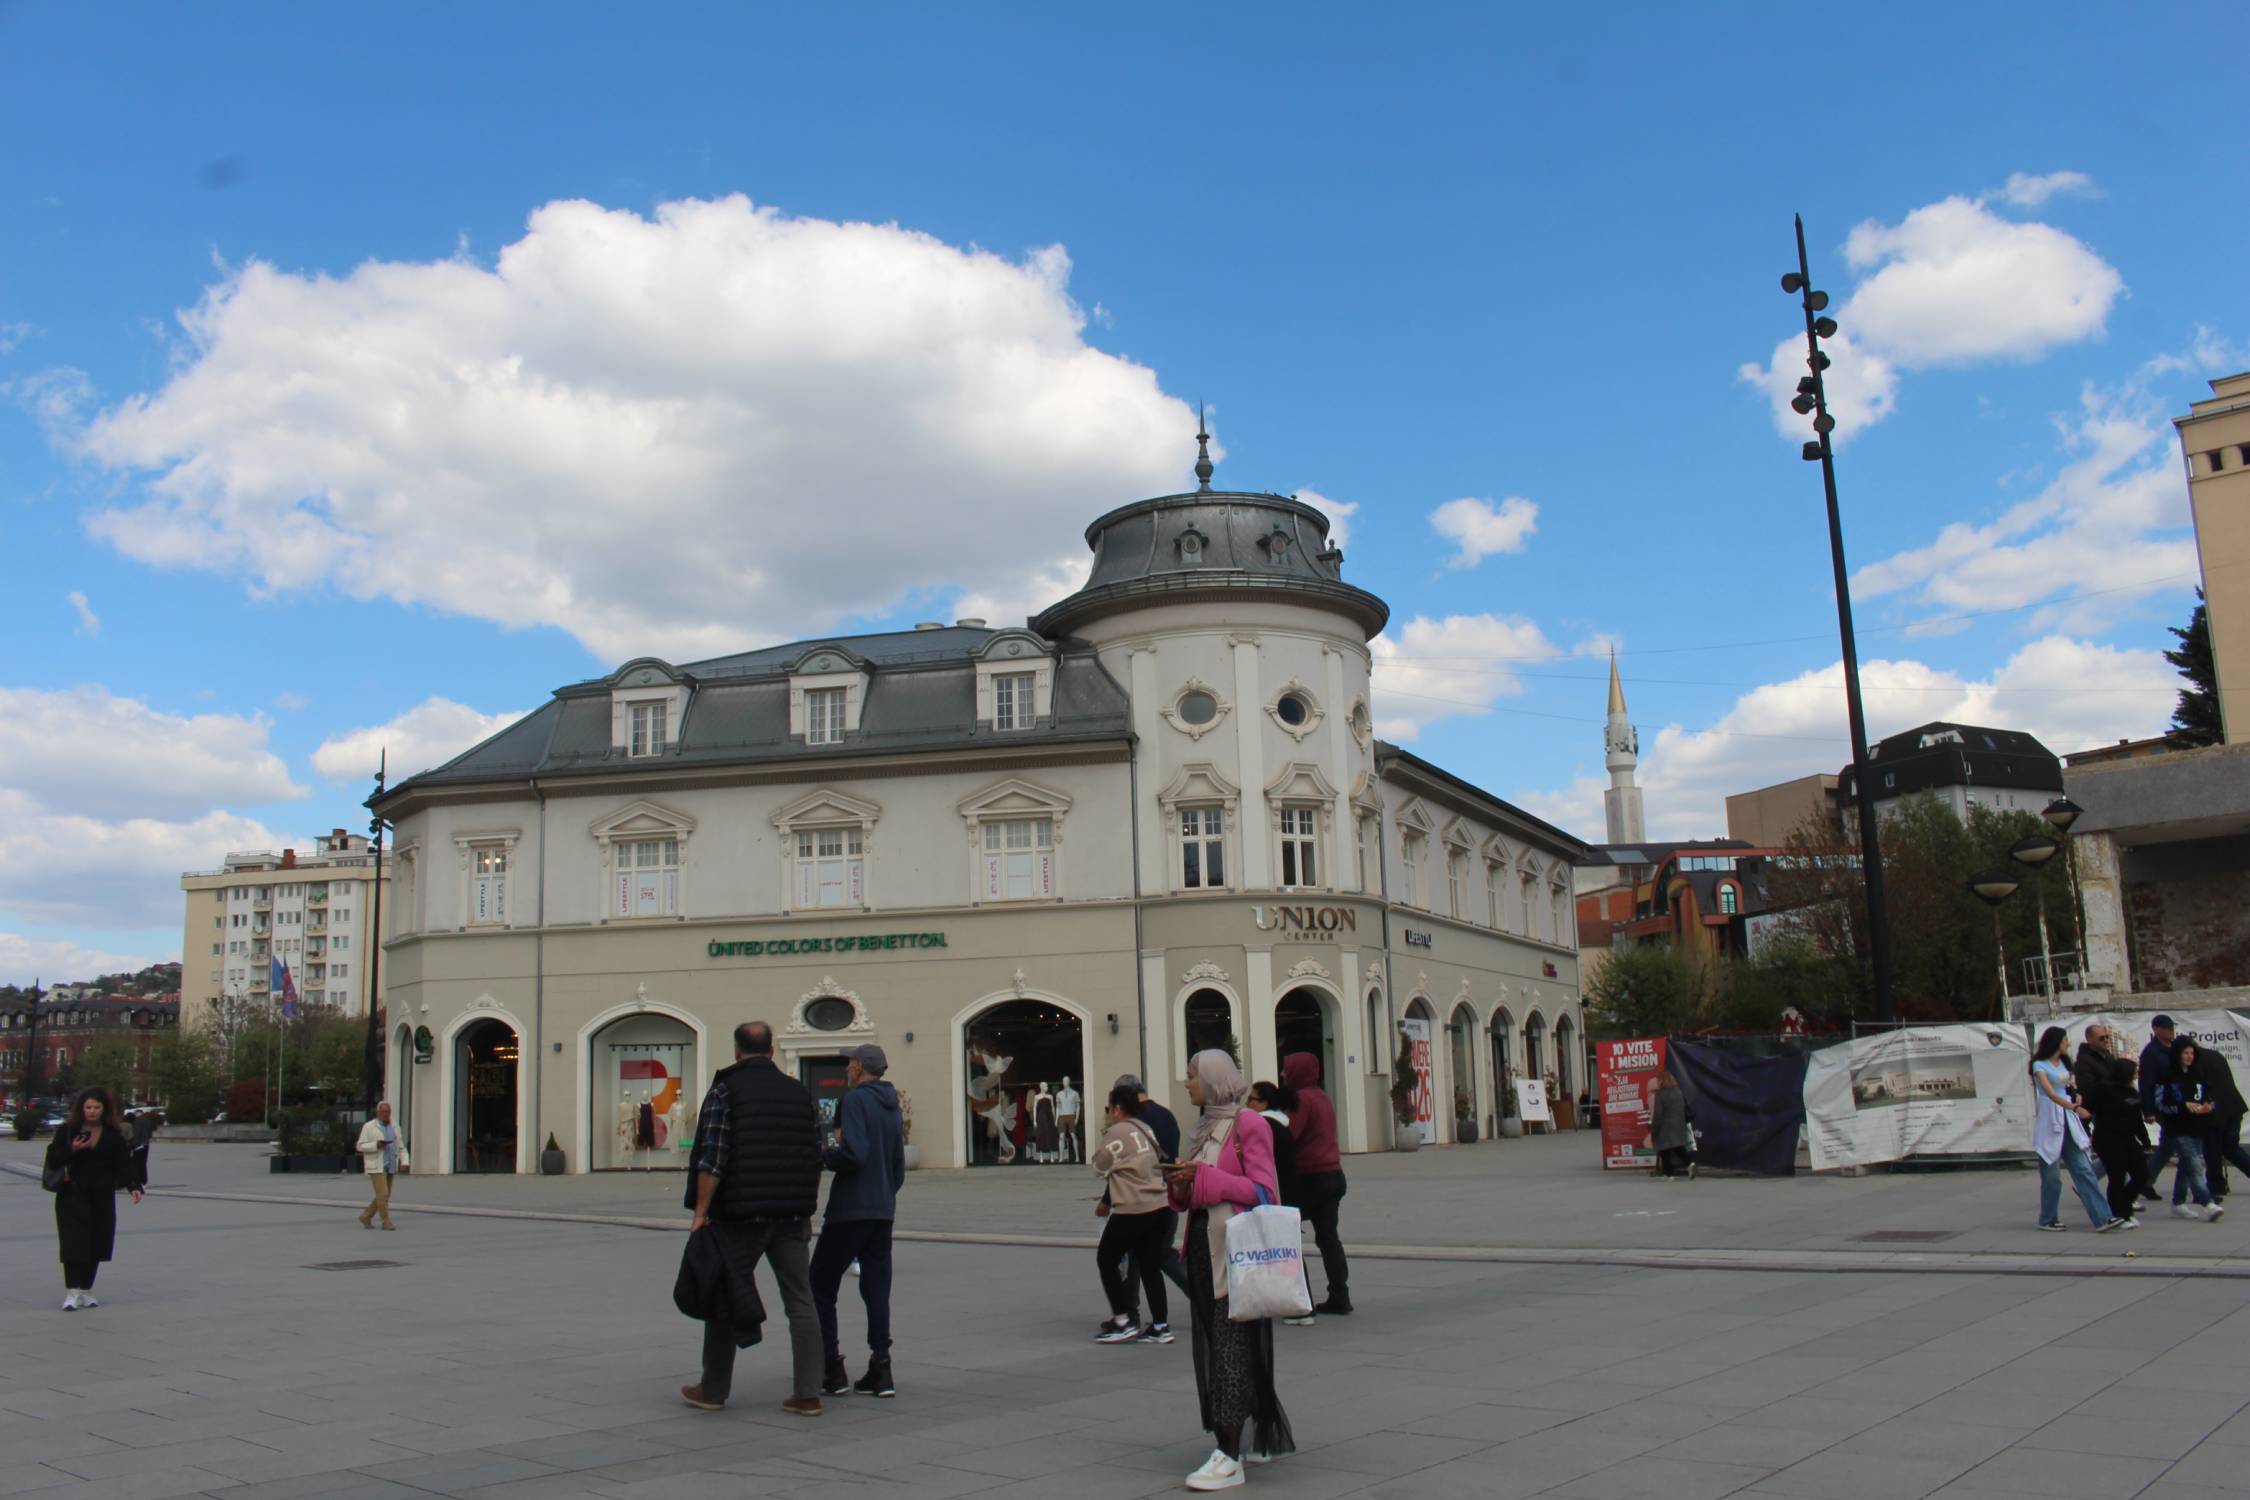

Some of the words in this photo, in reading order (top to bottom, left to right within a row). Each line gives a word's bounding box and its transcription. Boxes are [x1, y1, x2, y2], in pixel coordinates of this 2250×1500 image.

[1251, 906, 1356, 932] UNION
[1285, 932, 1334, 941] CENTER
[707, 939, 763, 957] UNITED
[766, 937, 833, 955] COLORS
[834, 936, 857, 952] OF
[2188, 1030, 2240, 1044] Project
[1612, 1043, 1624, 1056] 10
[1626, 1040, 1654, 1054] VITE
[1617, 1053, 1659, 1069] MISION
[1229, 1251, 1245, 1265] LC
